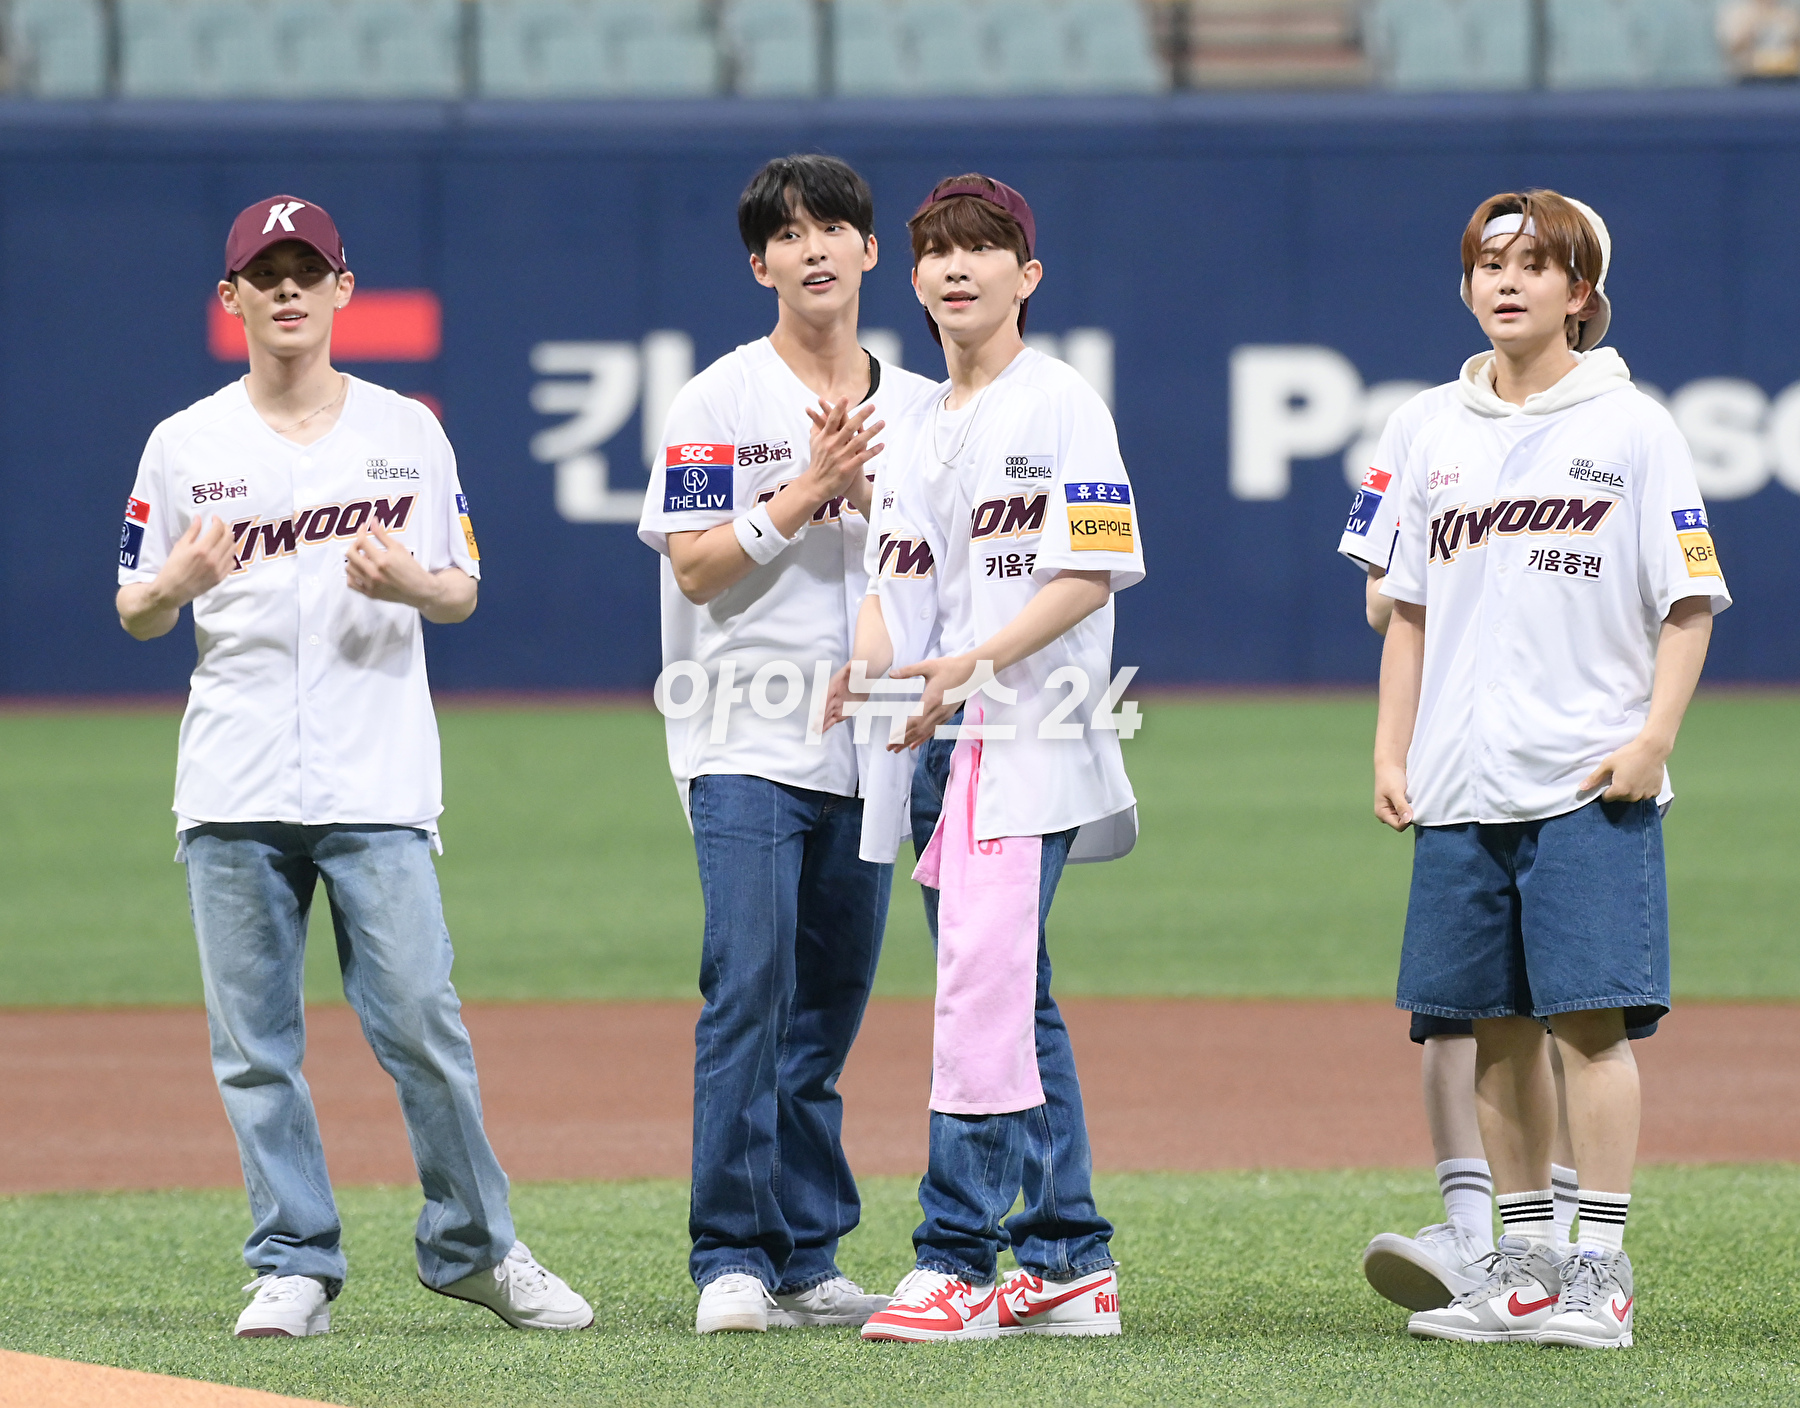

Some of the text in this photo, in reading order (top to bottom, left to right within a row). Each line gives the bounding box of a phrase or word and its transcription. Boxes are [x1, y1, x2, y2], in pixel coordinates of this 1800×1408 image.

[262, 201, 306, 235] K
[680, 445, 714, 462] SGC
[736, 443, 792, 467] 동광제약
[366, 467, 420, 480] 태안모터스
[1569, 467, 1624, 487] 태안모터스
[192, 481, 248, 504] 동광제약
[669, 494, 726, 510] THE LIV
[1071, 519, 1132, 537] KB라이프
[1429, 496, 1619, 564] KIWOOM
[1528, 549, 1602, 578] 키움증권
